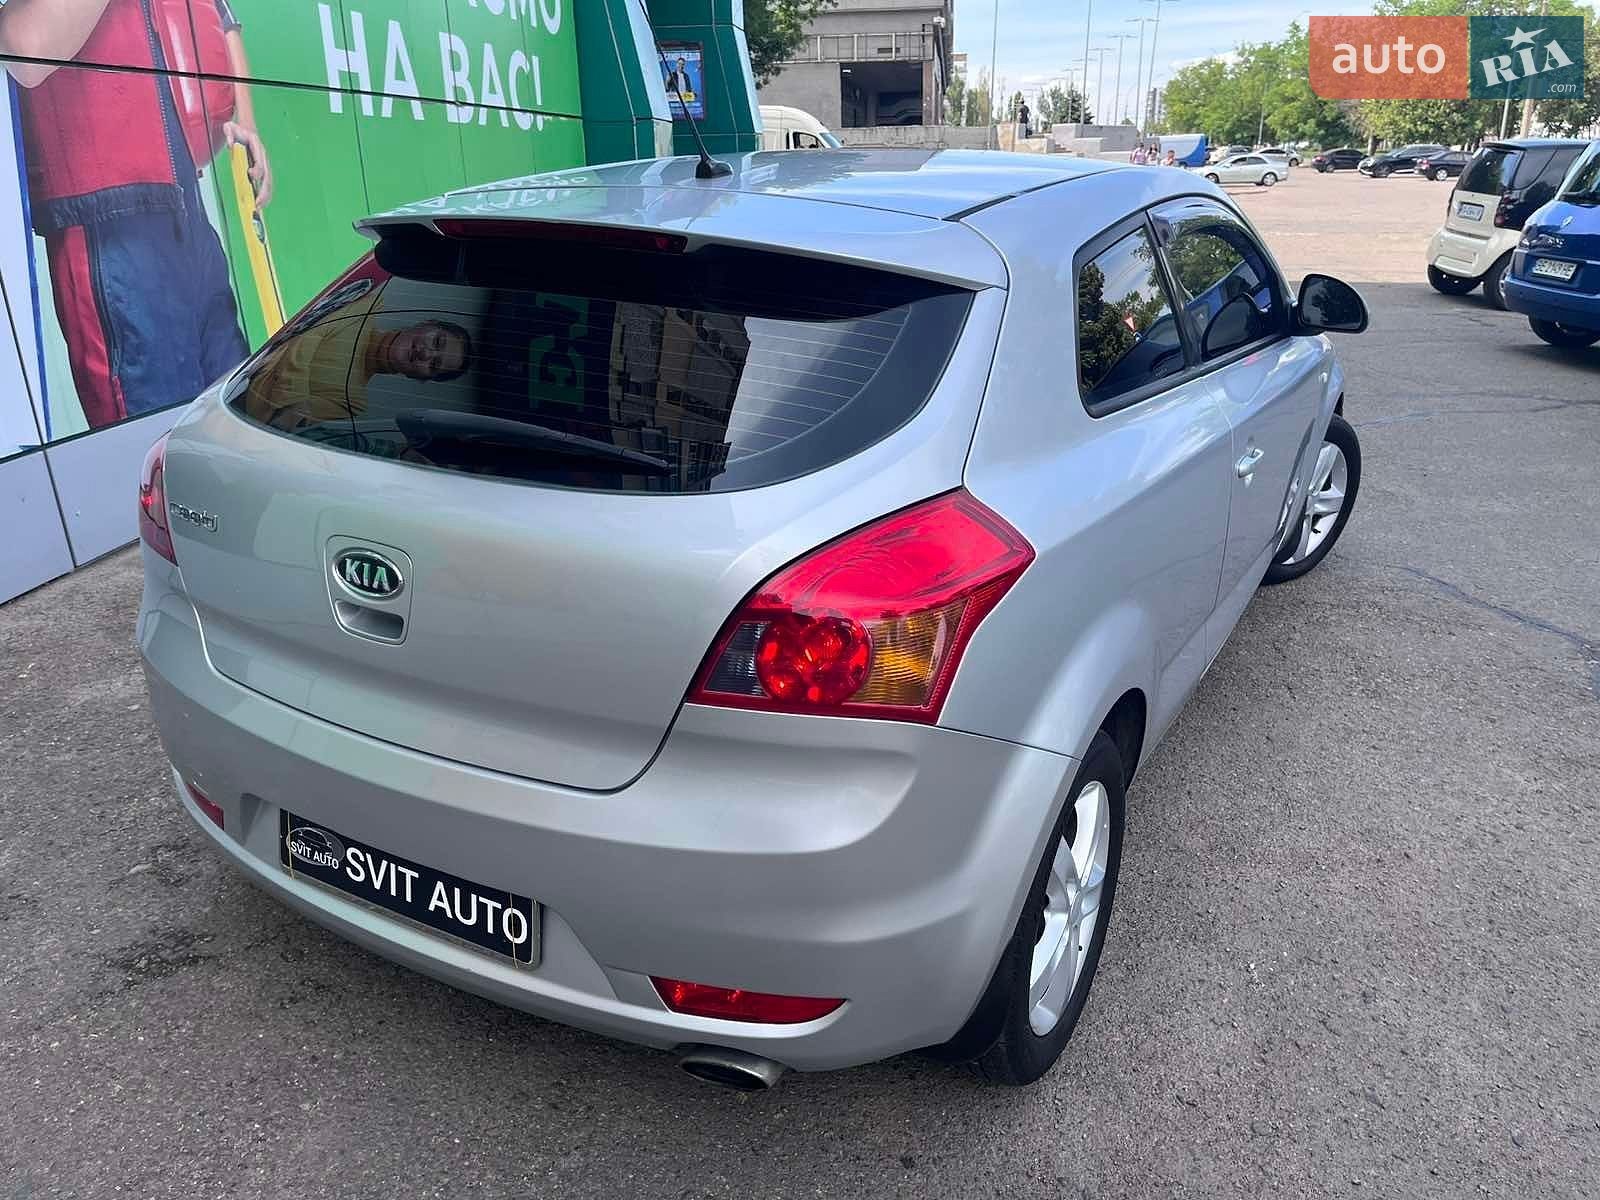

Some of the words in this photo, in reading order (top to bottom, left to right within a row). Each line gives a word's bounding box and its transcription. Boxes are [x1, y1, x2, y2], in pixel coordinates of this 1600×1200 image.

[318, 3, 424, 120] НА
[439, 32, 543, 131] ВАС!
[344, 558, 390, 591] KIA
[290, 841, 312, 859] SVIT
[313, 850, 339, 870] AUTO
[345, 847, 419, 903] SVIT
[428, 881, 528, 944] AUTO
